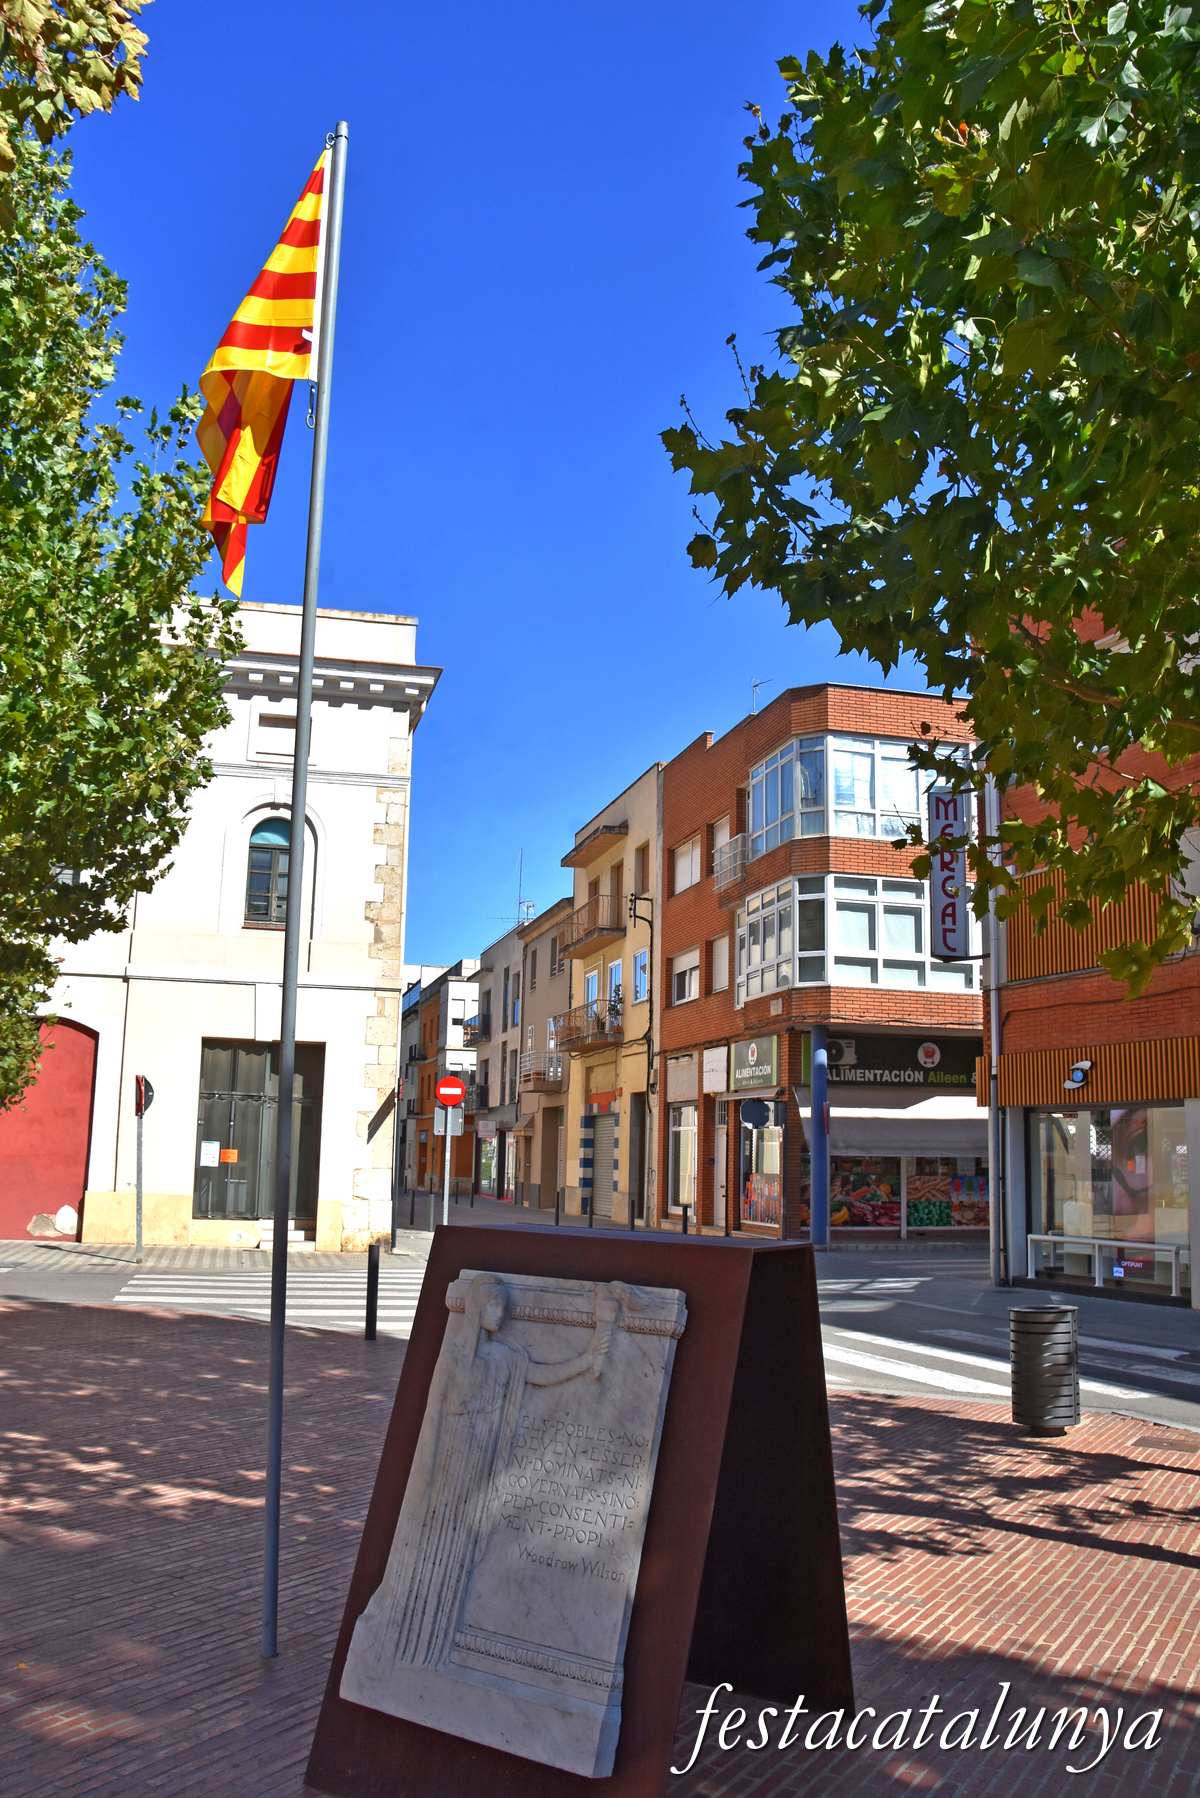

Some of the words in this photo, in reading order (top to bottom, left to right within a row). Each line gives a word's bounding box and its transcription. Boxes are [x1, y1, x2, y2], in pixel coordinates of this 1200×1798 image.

[735, 1062, 772, 1079] ALIMENTACIÓN
[927, 1071, 967, 1084] Aileen
[518, 1543, 578, 1574] Woodrow
[581, 1557, 625, 1583] Wilson
